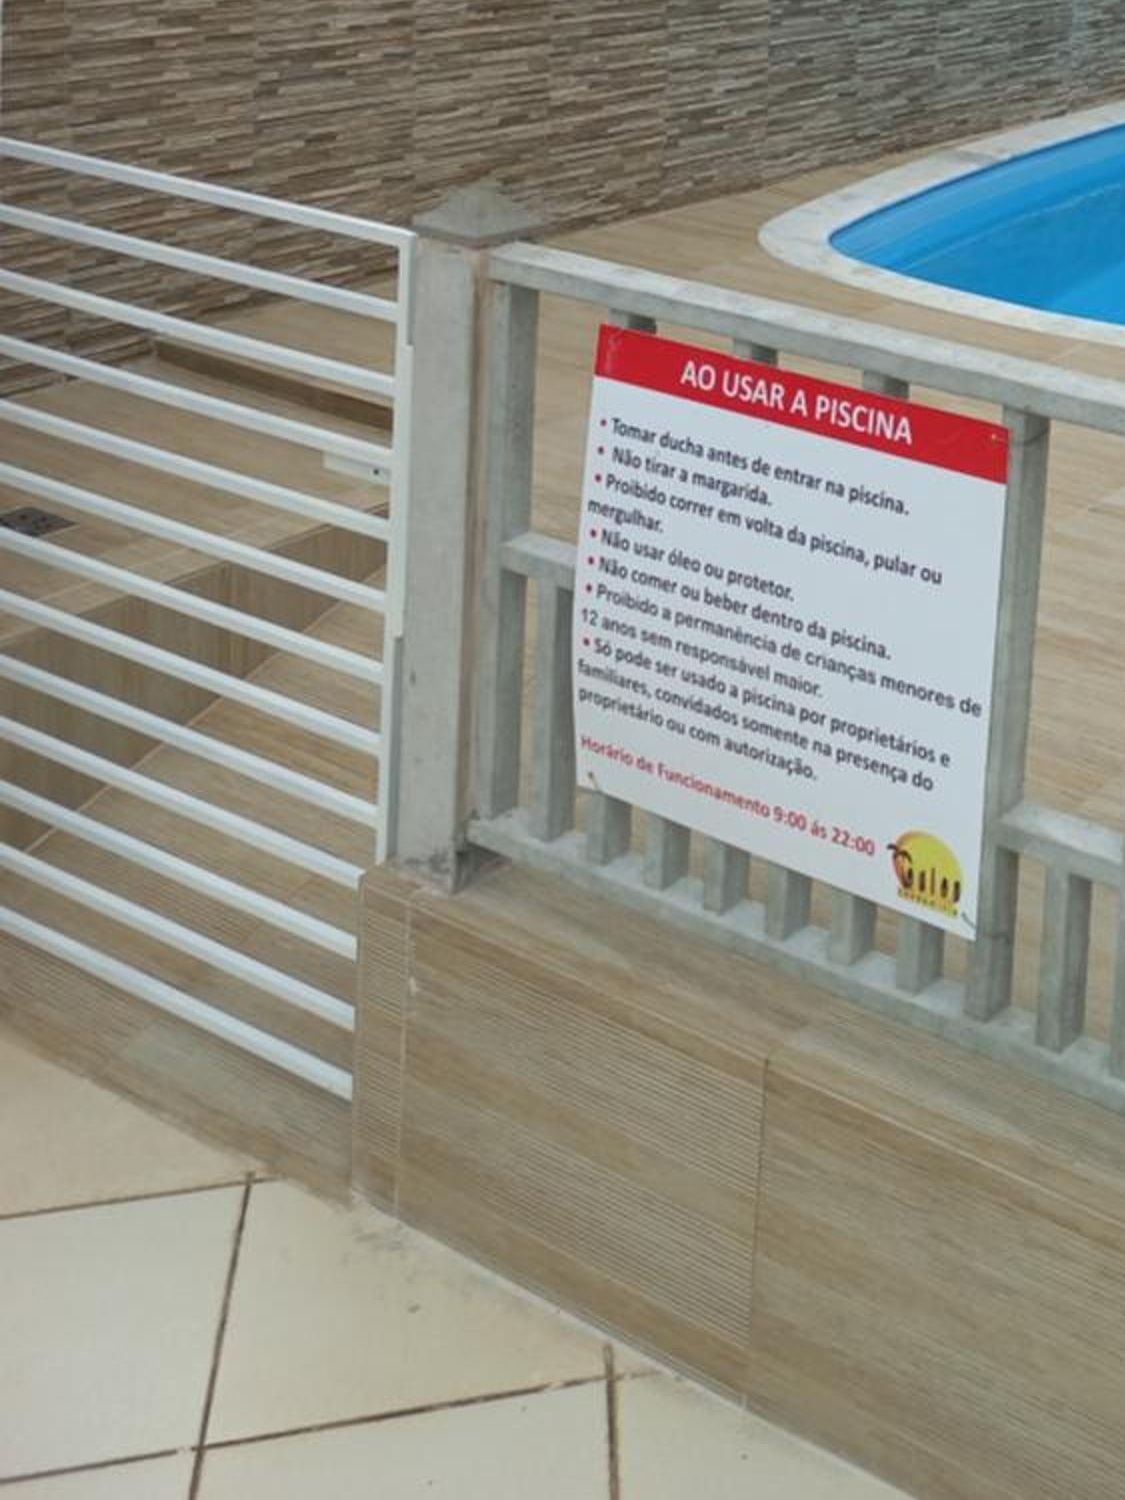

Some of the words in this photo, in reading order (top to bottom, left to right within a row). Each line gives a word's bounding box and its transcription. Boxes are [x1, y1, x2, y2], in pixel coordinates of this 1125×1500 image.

[680, 361, 716, 391] AO
[723, 371, 785, 410] USAR
[790, 389, 808, 417] A
[815, 395, 912, 444] PISCINA
[612, 417, 657, 444] Tomar
[659, 431, 704, 458] ducha
[706, 447, 748, 470] antes
[751, 457, 771, 476] de
[774, 466, 822, 490] entrar
[825, 480, 845, 498] na
[848, 485, 909, 516] piscina.
[612, 446, 642, 469] Não
[645, 457, 676, 478] tirar
[679, 469, 688, 483] a
[692, 472, 773, 506] margarida.
[588, 500, 663, 533] mergulhar.
[601, 528, 630, 552] Não
[633, 542, 665, 561] usar
[668, 548, 701, 573] óleo
[704, 563, 724, 580] ou
[727, 570, 794, 601] protetor.
[605, 473, 666, 505] Proibido
[669, 495, 714, 518] correr
[717, 509, 741, 527] em
[745, 517, 784, 539] volta
[787, 526, 806, 546] da
[810, 534, 870, 567] piscina,
[873, 554, 917, 577] pular
[920, 567, 942, 585] ou
[581, 608, 598, 627] 12
[601, 617, 637, 639] anos
[640, 630, 672, 649] sem
[675, 640, 770, 681] responsável
[773, 671, 822, 697] maior.
[596, 583, 659, 617] Proibido
[662, 608, 672, 621] a
[674, 611, 777, 654] permanência
[780, 643, 801, 661] de
[804, 652, 876, 685] crianças
[880, 675, 955, 709] menores
[959, 697, 982, 717] de
[599, 556, 628, 580] Não
[631, 570, 678, 593] comer
[680, 585, 700, 602] ou
[703, 587, 748, 615] beber
[751, 604, 804, 633] dentro
[806, 621, 827, 640] da
[830, 629, 891, 660] piscina.
[578, 658, 652, 699] familiares,
[654, 688, 738, 726] convidados
[742, 716, 809, 750] somente
[812, 740, 832, 757] na
[836, 748, 908, 783] presença
[911, 771, 934, 791] do
[578, 688, 664, 727] proprietário
[666, 718, 686, 735] ou
[688, 726, 721, 747] com
[724, 738, 818, 780] autorização.
[594, 637, 612, 657] Só
[615, 648, 652, 670] pode
[655, 660, 678, 678] ser
[681, 669, 726, 694] usado
[729, 685, 739, 699] a
[742, 689, 796, 717] piscina
[799, 707, 827, 726] por
[830, 718, 936, 763] proprietários
[940, 753, 950, 768] e
[581, 735, 634, 766] Horário
[636, 756, 654, 773] de
[657, 762, 770, 818] Funcionamento
[773, 806, 807, 831] 9:00
[831, 827, 875, 856] 22:00
